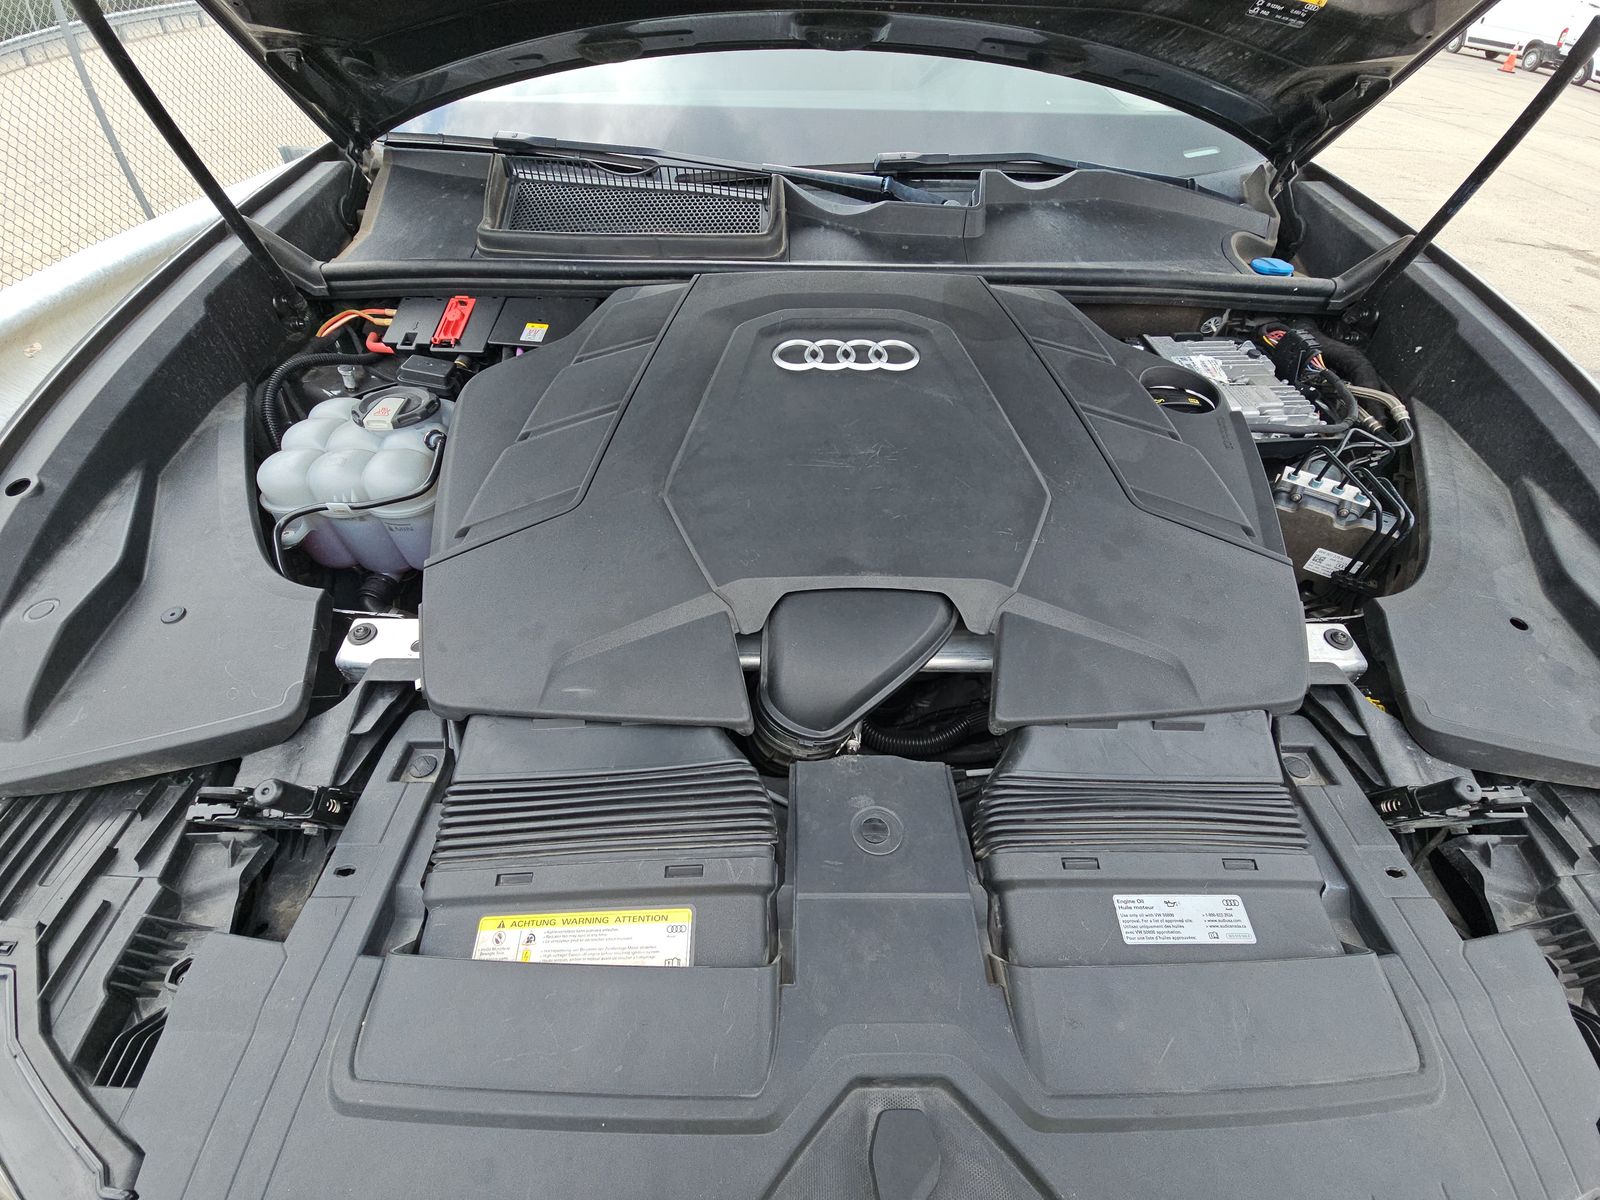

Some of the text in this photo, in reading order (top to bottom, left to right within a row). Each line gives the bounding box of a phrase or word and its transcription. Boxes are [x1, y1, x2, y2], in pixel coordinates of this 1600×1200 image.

[510, 914, 669, 928] ACHTUNG WARNING ATTENTION
